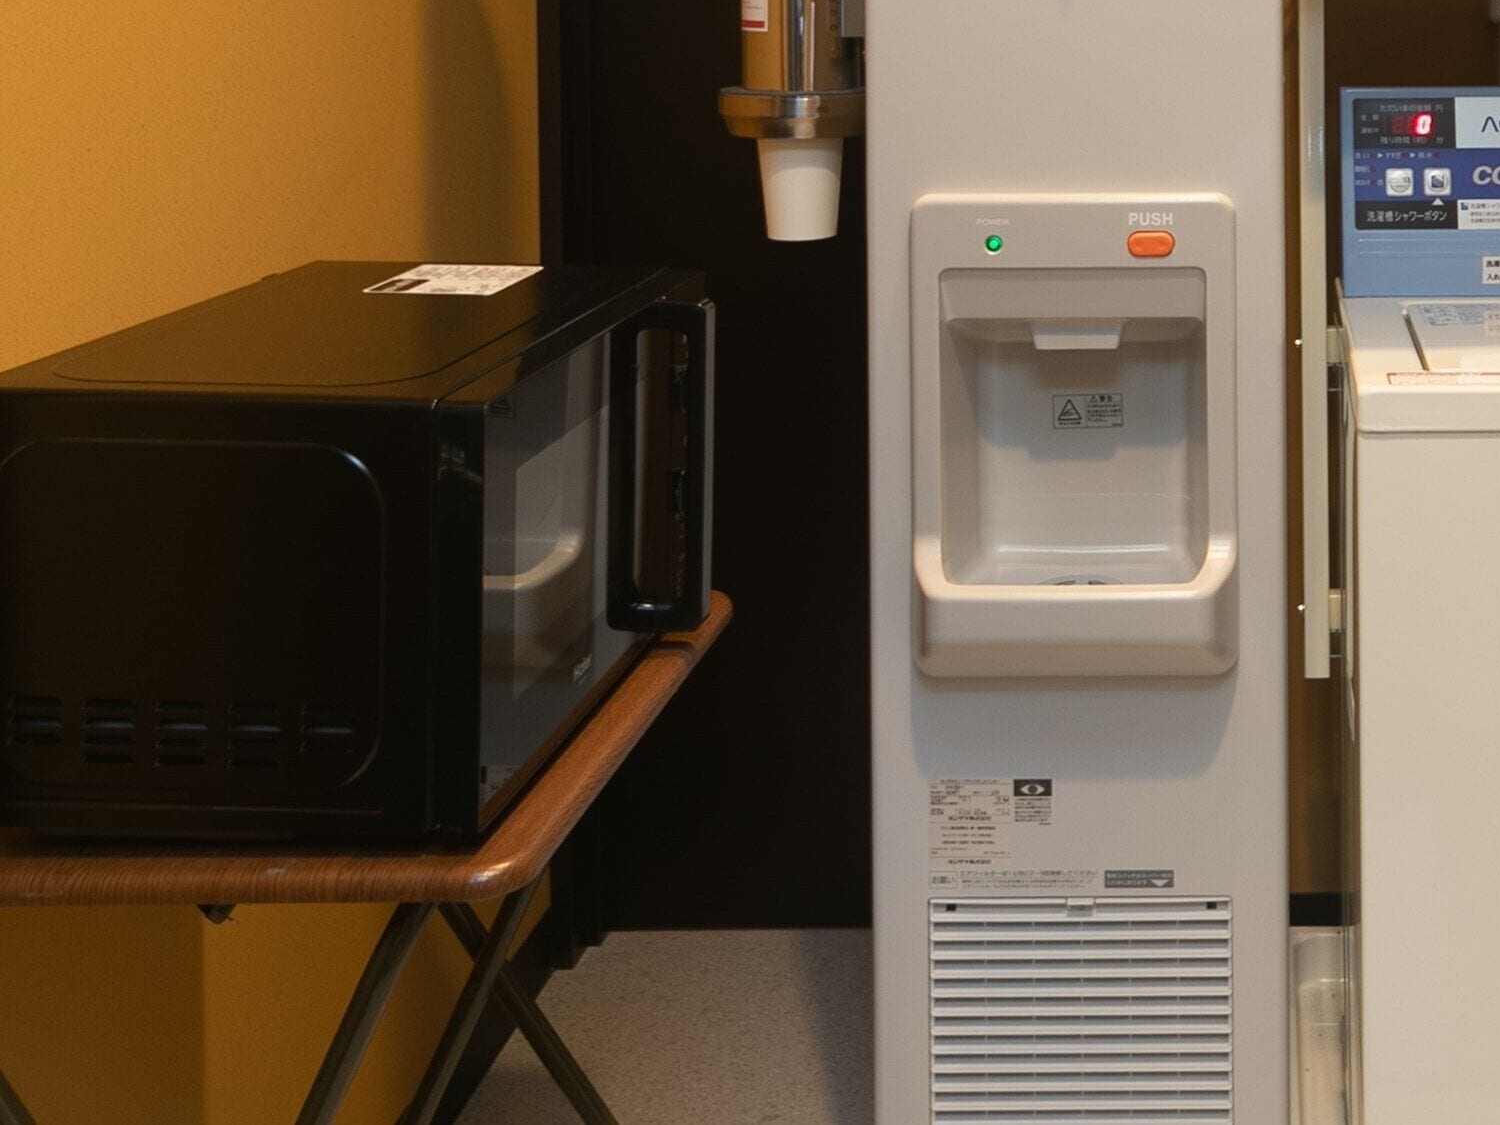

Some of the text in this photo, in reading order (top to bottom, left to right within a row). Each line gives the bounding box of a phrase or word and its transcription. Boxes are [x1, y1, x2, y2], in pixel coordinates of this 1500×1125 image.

[976, 218, 1010, 226] POWER
[1128, 212, 1174, 225] PUSH
[1366, 211, 1448, 223] 洗濯槽シャワーボタン
